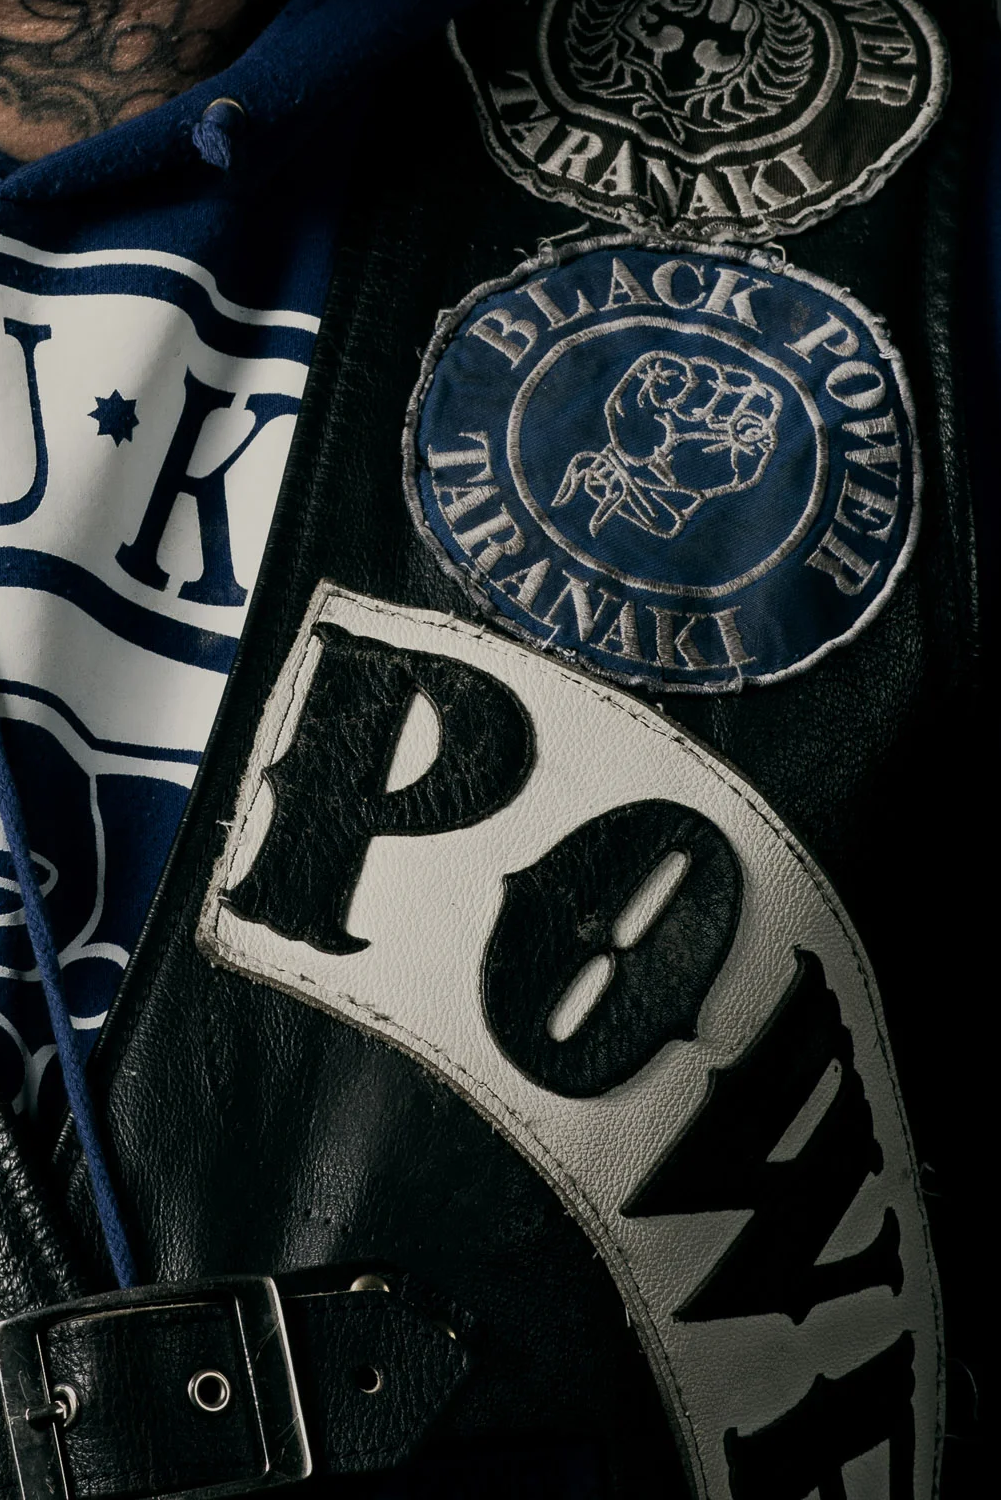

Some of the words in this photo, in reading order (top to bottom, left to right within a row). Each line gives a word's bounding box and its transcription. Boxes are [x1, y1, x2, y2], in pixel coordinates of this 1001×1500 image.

[489, 70, 833, 219] TARANAKI
[465, 256, 774, 370] BLACK
[784, 311, 902, 596] POWER
[427, 429, 758, 670] TARANAKI
